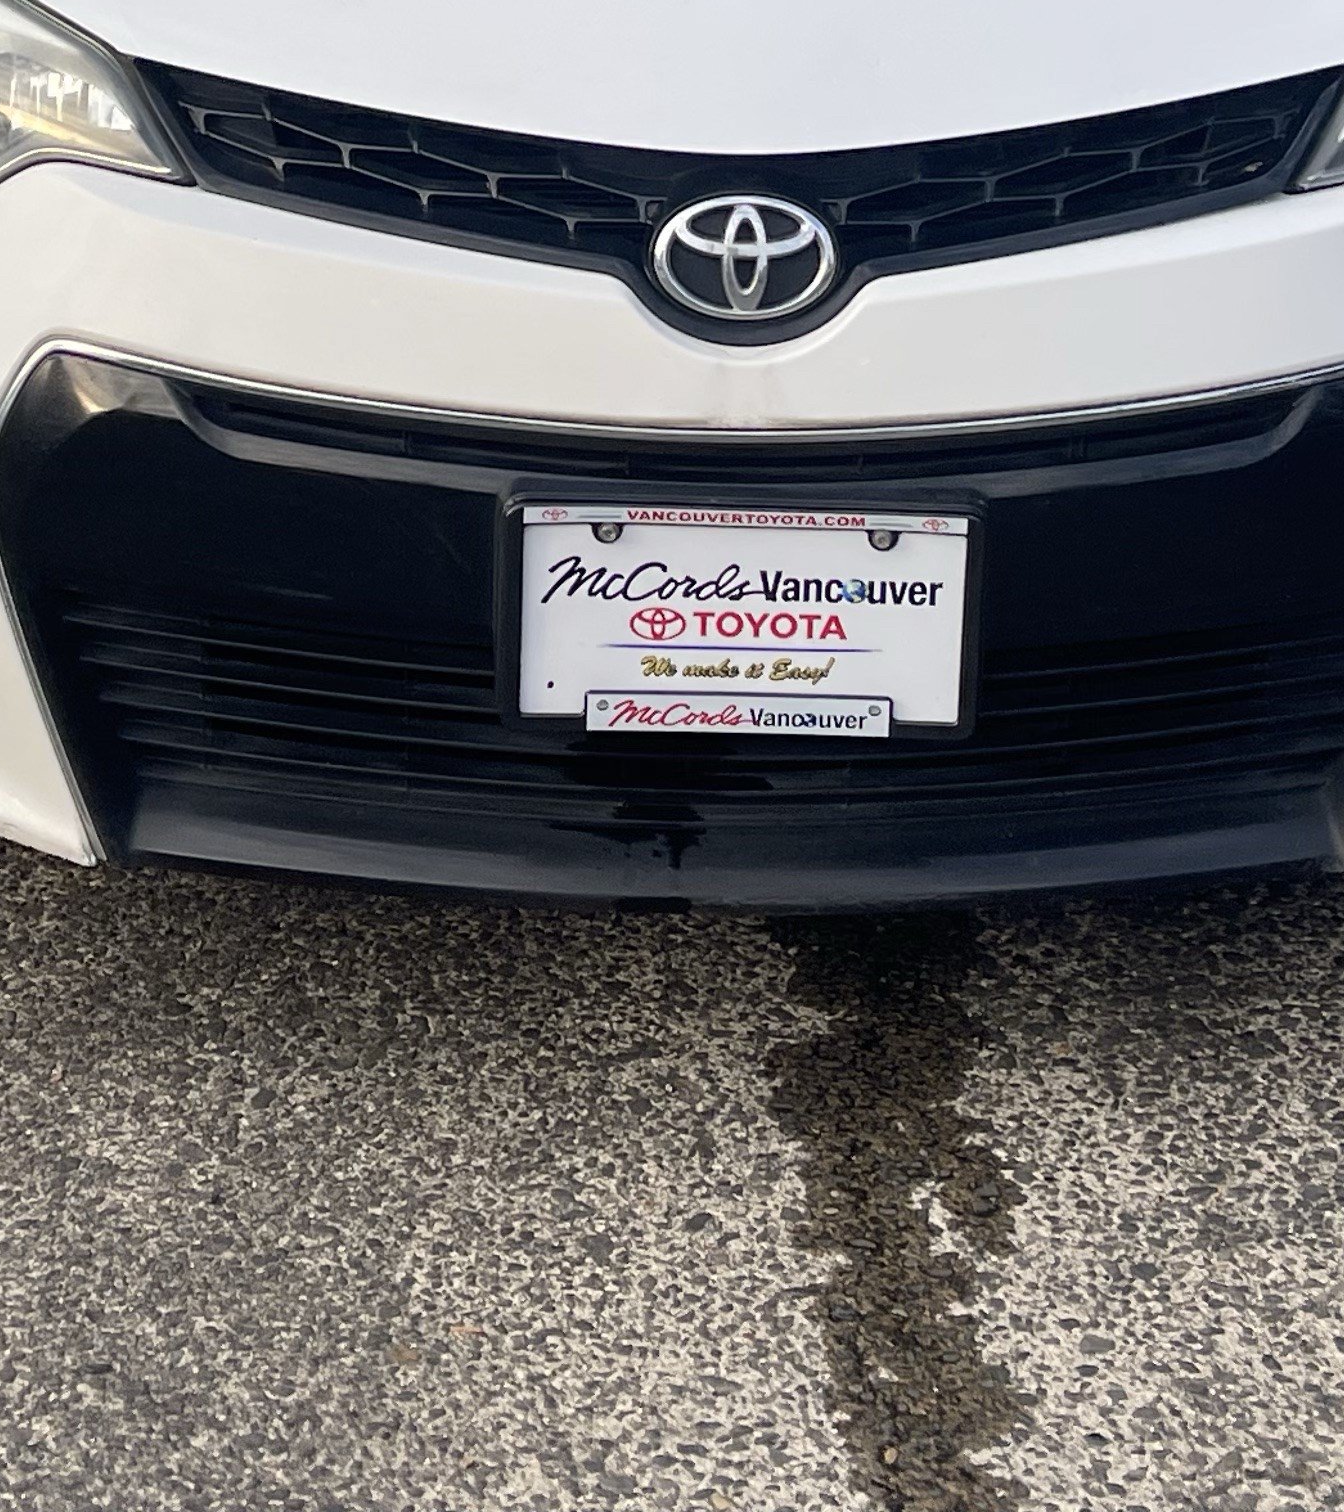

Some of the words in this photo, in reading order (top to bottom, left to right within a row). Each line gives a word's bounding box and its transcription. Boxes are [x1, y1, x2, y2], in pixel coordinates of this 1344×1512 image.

[627, 510, 866, 527] VANCOUVERTOYOTA.COM
[693, 611, 848, 641] TOYOTA
[640, 655, 678, 677] We
[682, 657, 740, 678] make
[744, 662, 765, 679] it
[768, 656, 836, 686] Easy!
